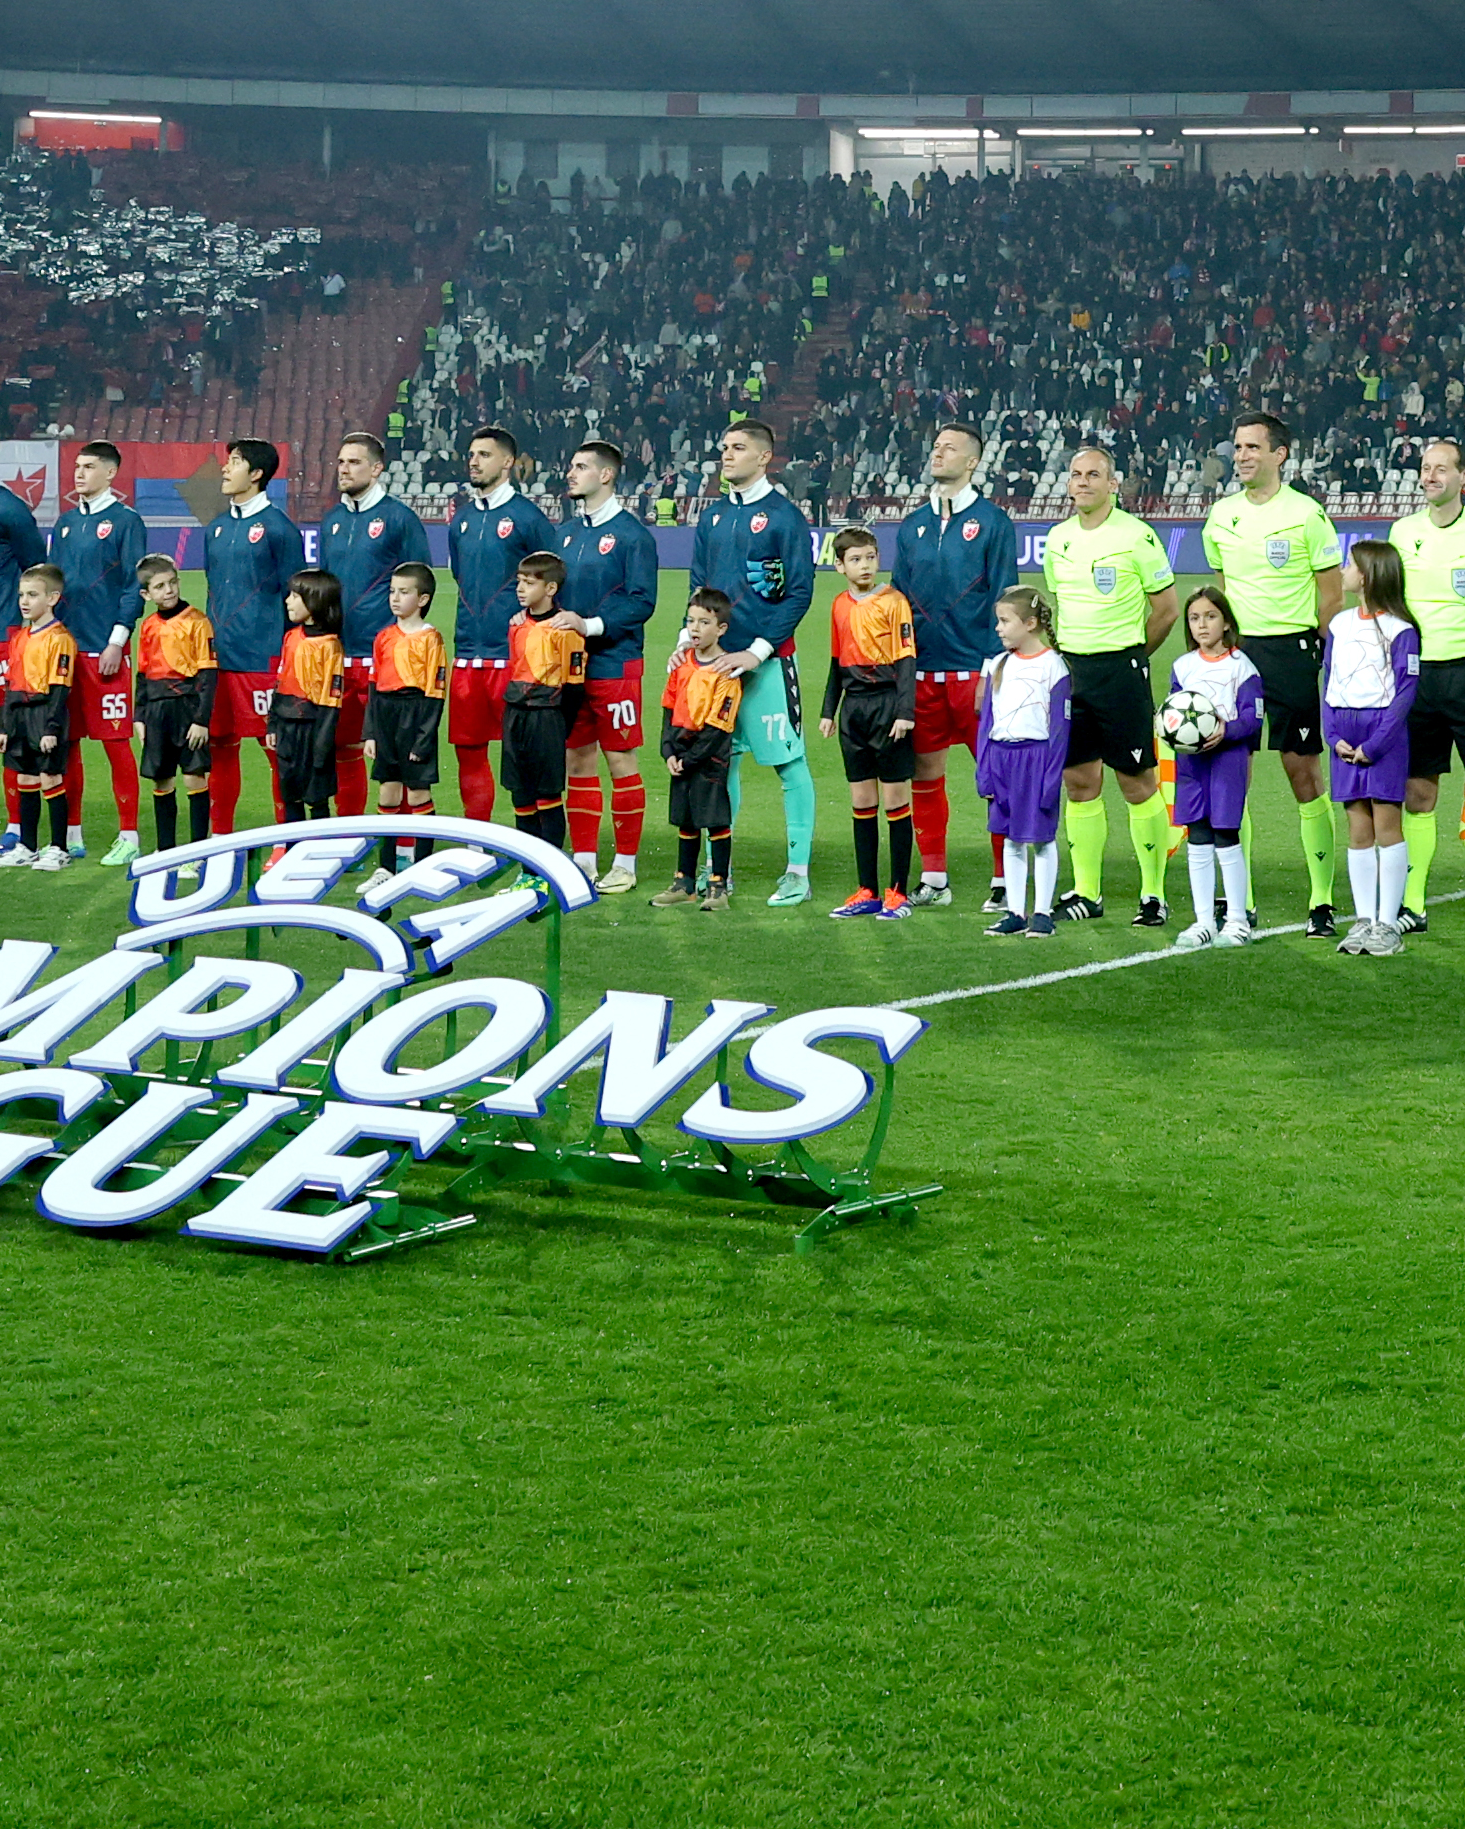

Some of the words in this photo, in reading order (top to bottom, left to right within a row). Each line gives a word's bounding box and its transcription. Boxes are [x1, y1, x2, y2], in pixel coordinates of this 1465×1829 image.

[101, 693, 127, 720] 55
[607, 699, 636, 729] 70
[761, 712, 786, 741] 77
[130, 836, 546, 972] UEFA
